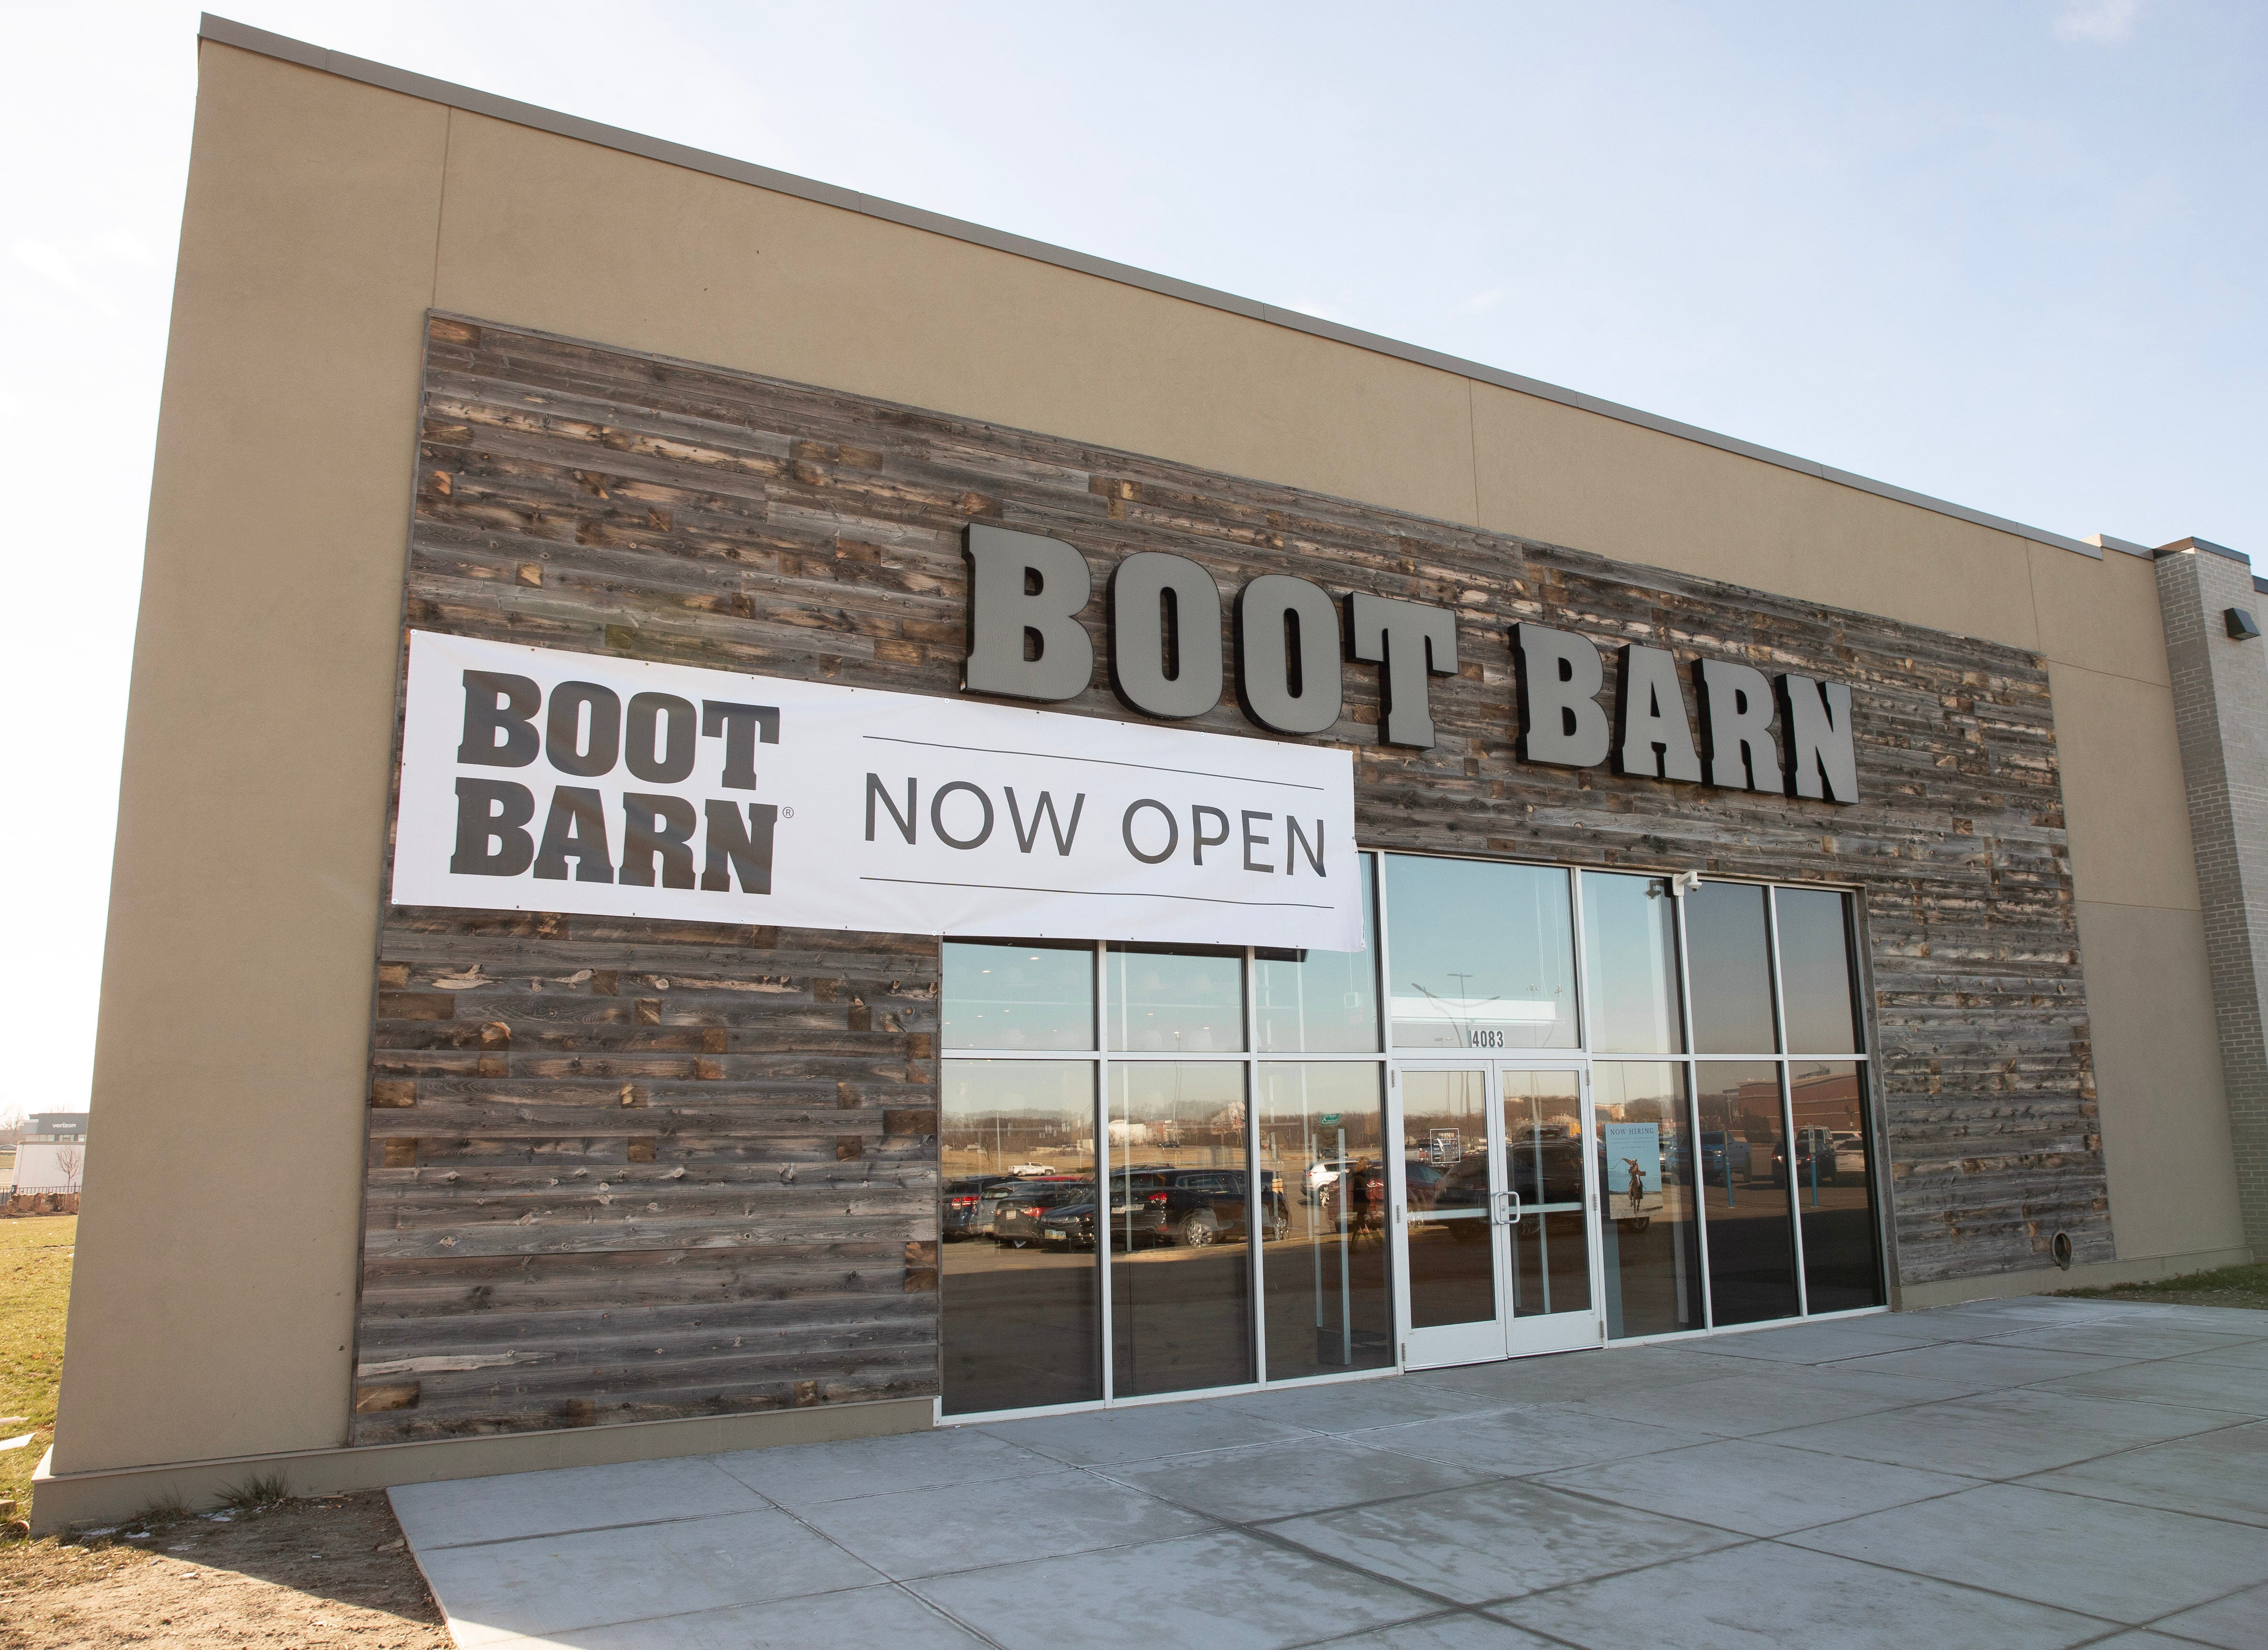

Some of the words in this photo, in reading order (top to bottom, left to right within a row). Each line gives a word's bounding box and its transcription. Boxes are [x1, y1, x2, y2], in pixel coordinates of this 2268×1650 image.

[960, 522, 1460, 752] BOOT
[1508, 622, 1860, 806] BARN
[457, 669, 780, 790] BOOT
[450, 777, 778, 895] BARN
[865, 772, 1085, 856] NOW
[1122, 798, 1326, 877] OPEN
[1473, 1030, 1504, 1047] 4083
